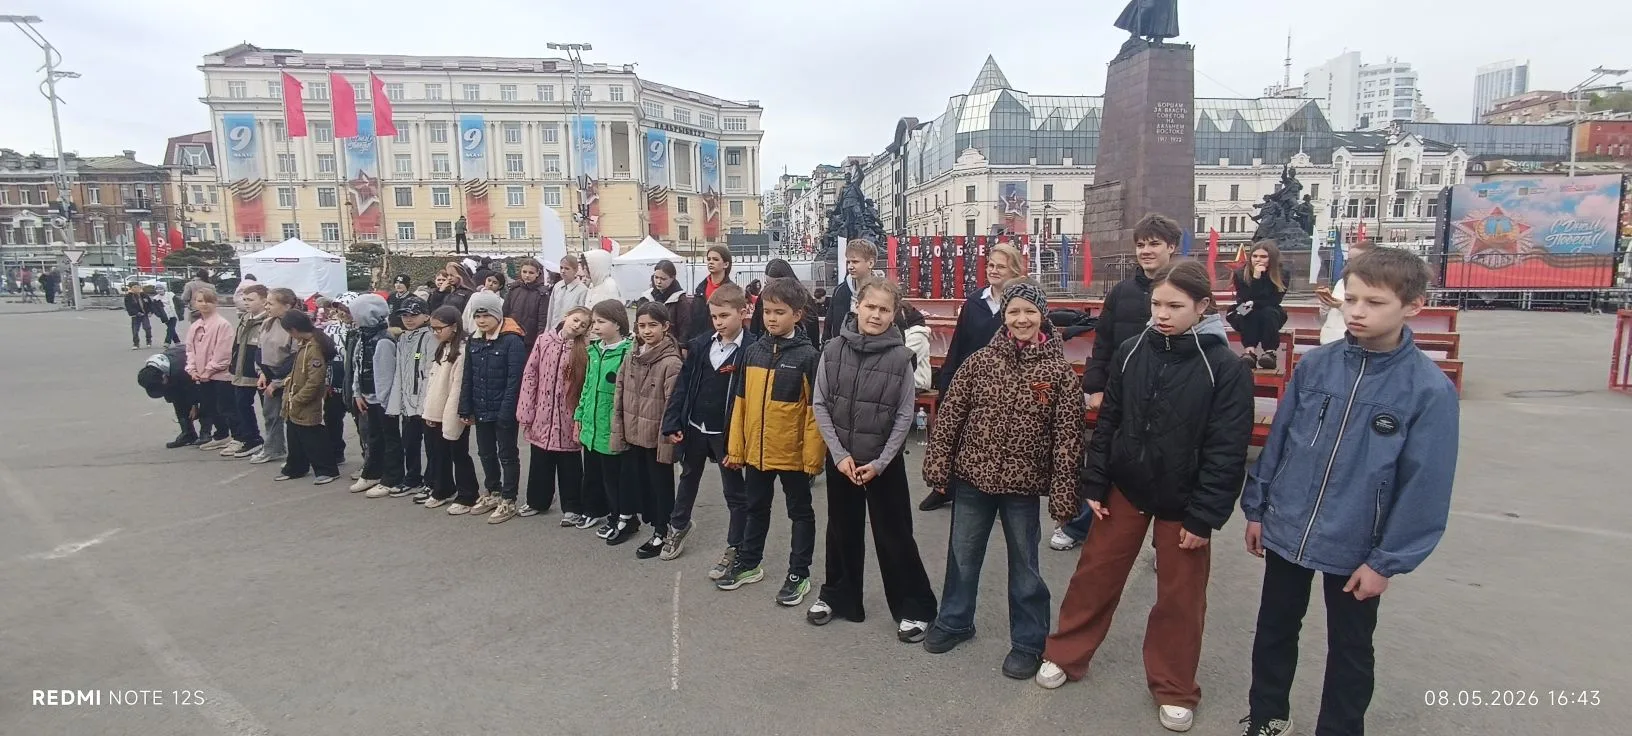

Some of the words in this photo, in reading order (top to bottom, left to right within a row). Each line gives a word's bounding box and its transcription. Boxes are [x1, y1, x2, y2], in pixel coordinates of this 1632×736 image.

[229, 126, 252, 151] 9
[463, 128, 482, 150] 9
[650, 141, 664, 162] 9
[911, 245, 1030, 257] ПОБЕА
